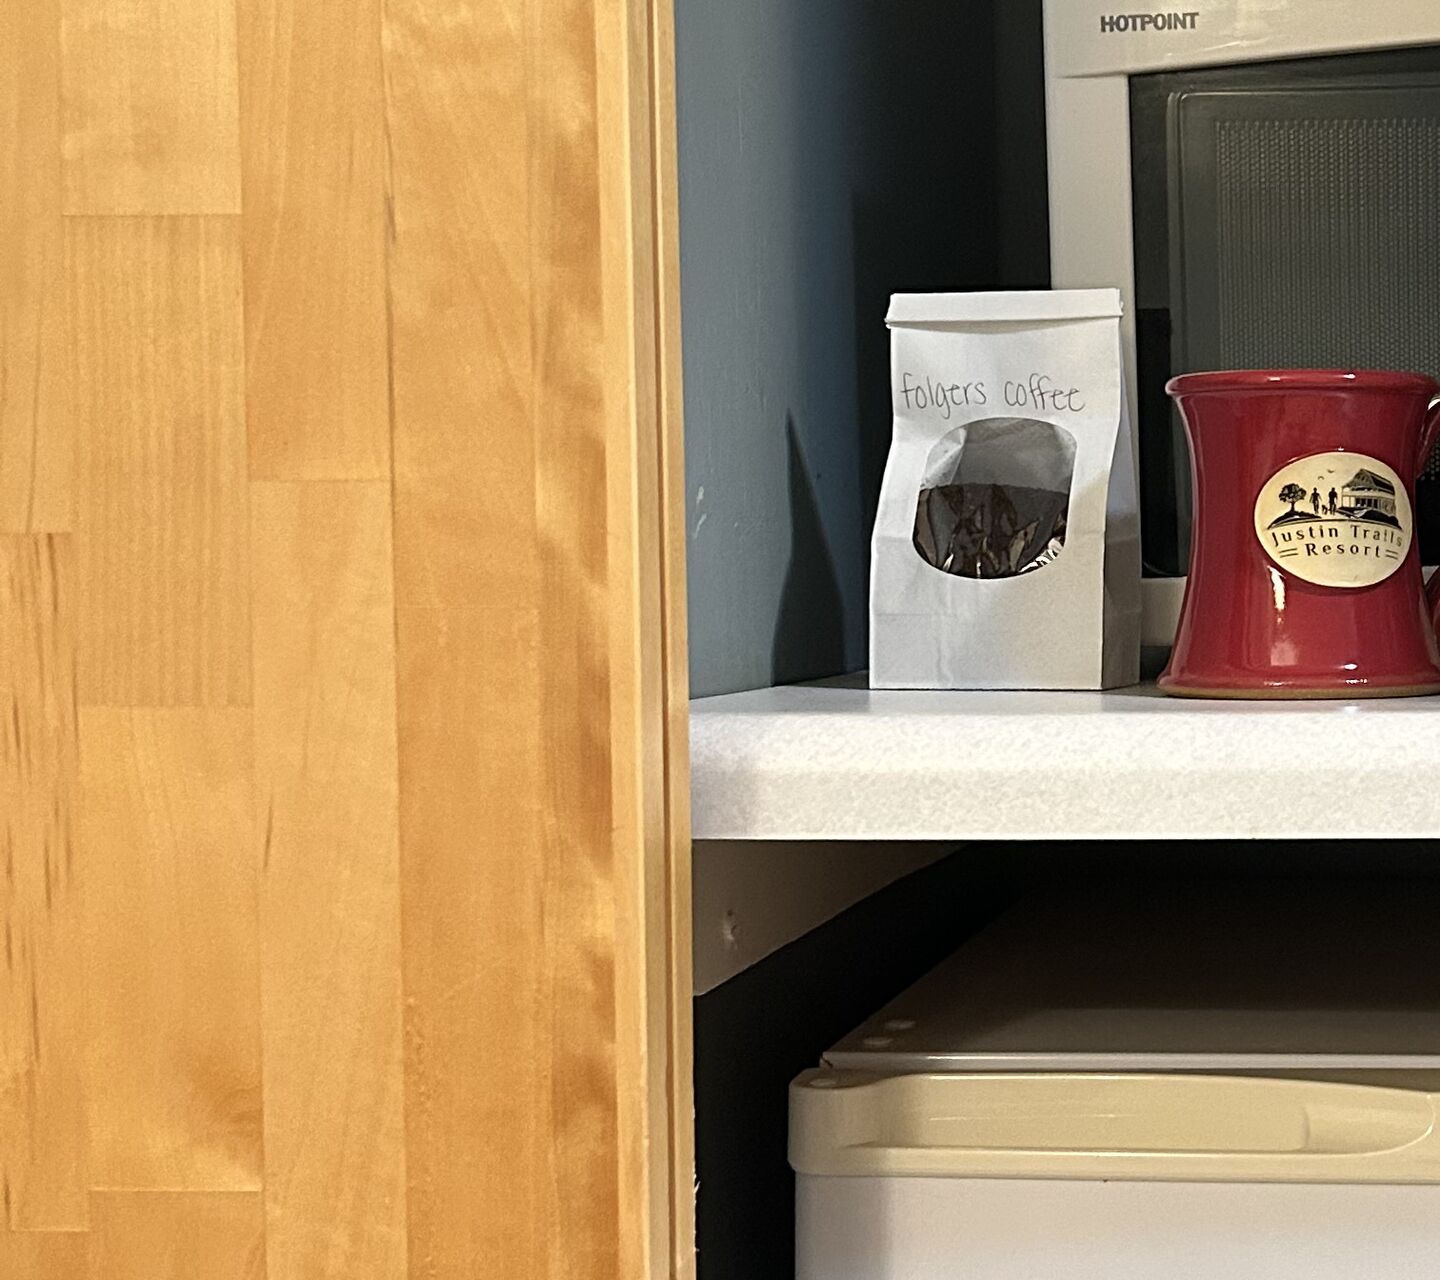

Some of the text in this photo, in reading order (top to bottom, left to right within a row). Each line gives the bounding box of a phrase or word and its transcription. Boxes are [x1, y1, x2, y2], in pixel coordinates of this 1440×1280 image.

[1100, 12, 1200, 33] HOTPOINT
[1003, 372, 1086, 412] coffee
[1271, 524, 1403, 547] Justin Trails
[1305, 542, 1381, 558] Resort
